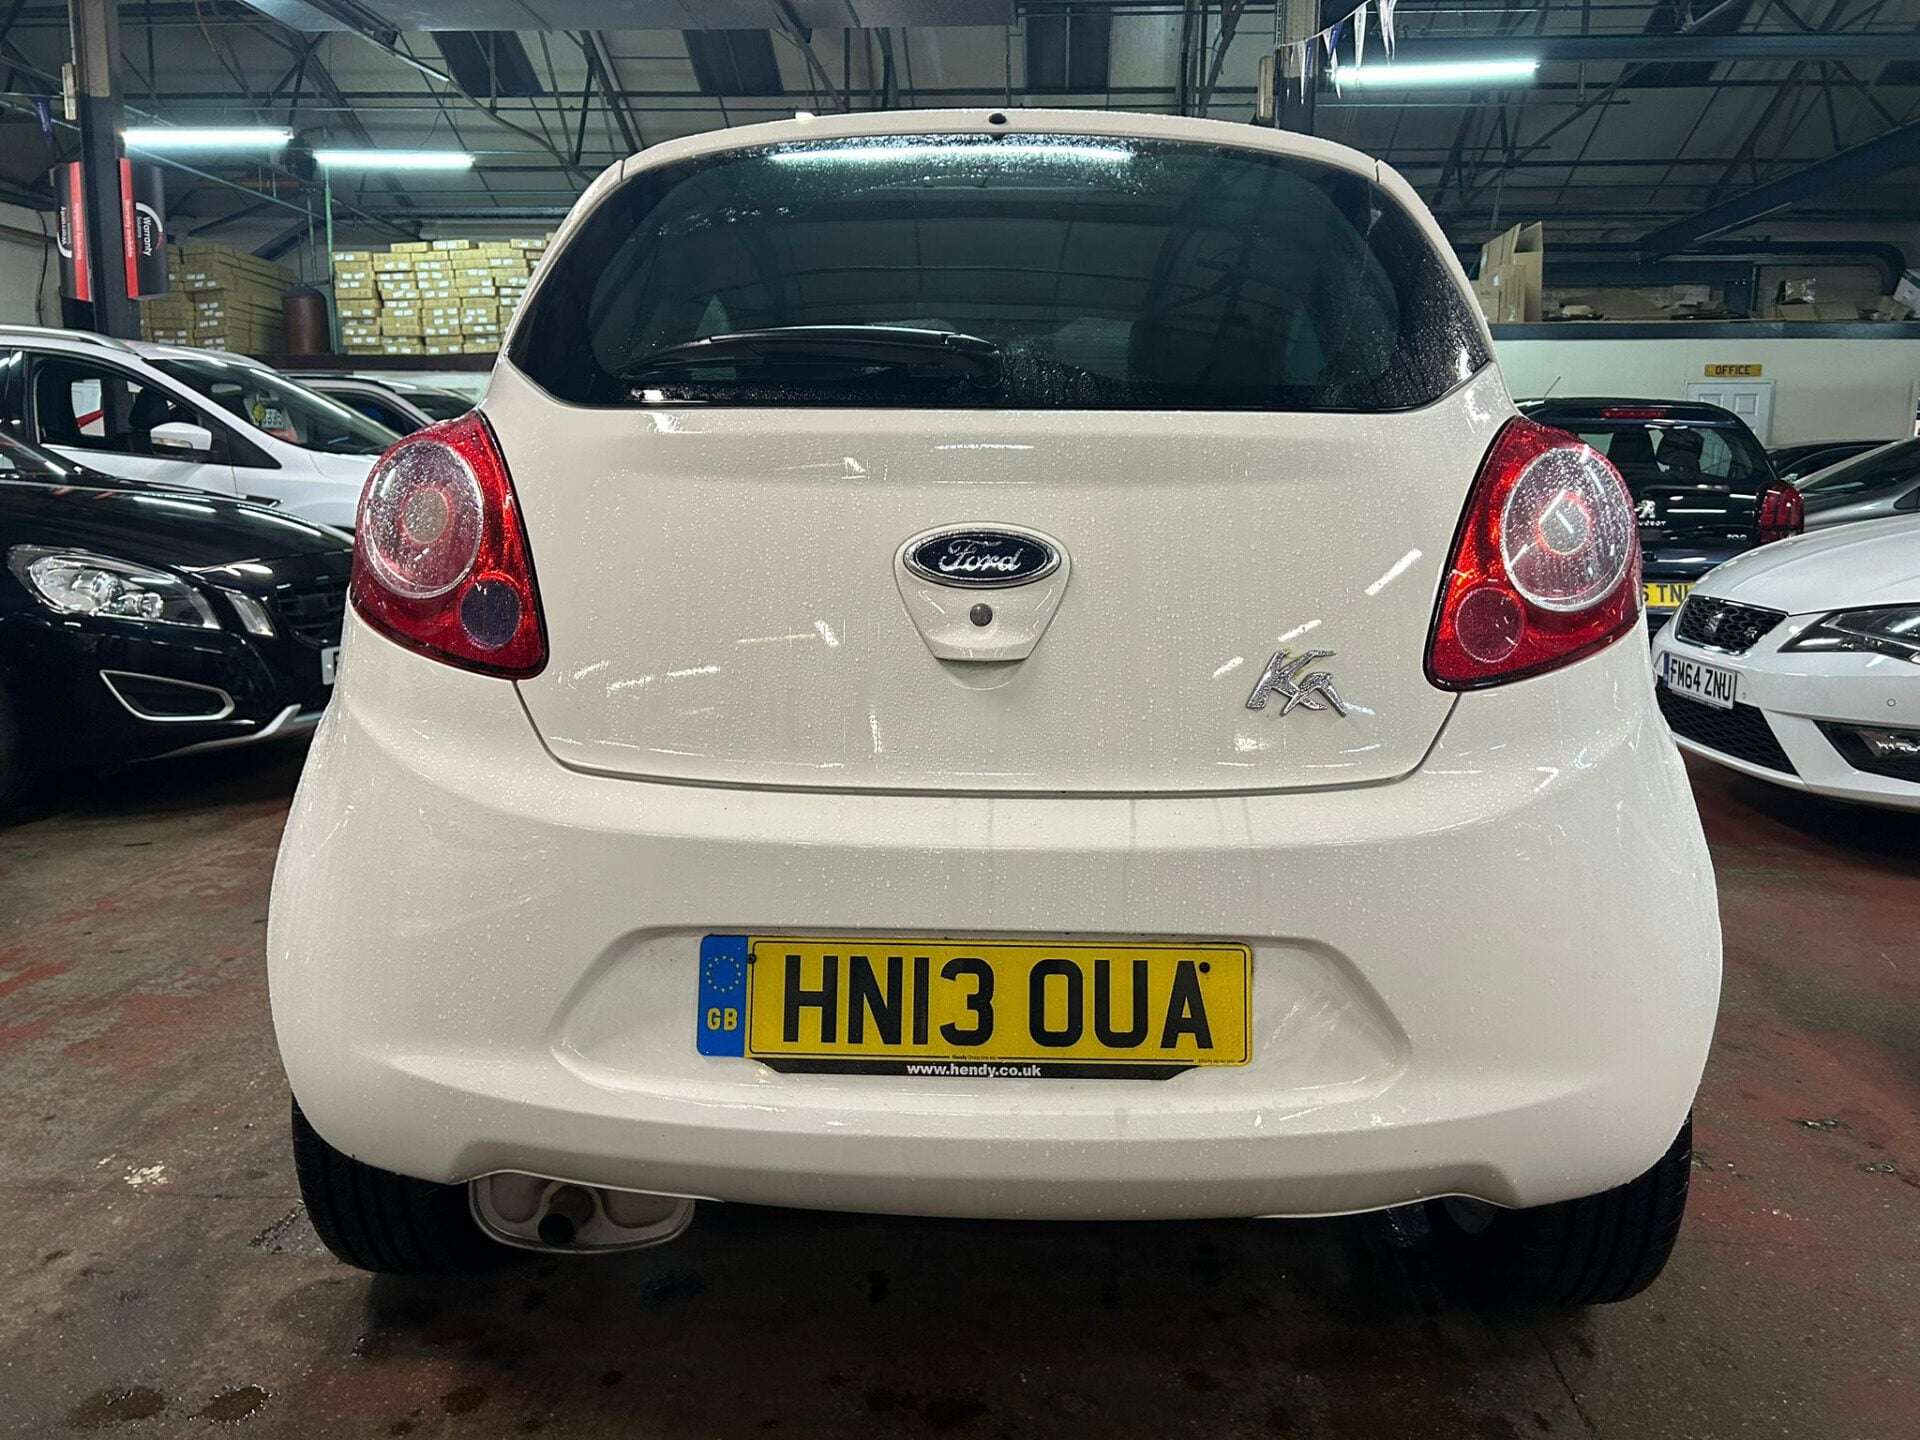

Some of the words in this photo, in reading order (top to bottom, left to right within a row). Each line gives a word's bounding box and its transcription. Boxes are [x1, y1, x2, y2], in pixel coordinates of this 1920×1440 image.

[142, 216, 152, 257] Warranty
[1715, 364, 1751, 376] OFFICE
[938, 539, 1024, 571] Ford
[1670, 658, 1701, 692] FM64
[1704, 668, 1732, 702] ZNU
[782, 955, 994, 1048] HN13
[1028, 958, 1214, 1050] OUA
[707, 1010, 738, 1031] GB
[906, 1063, 1041, 1078] www.hendy.co.uk
